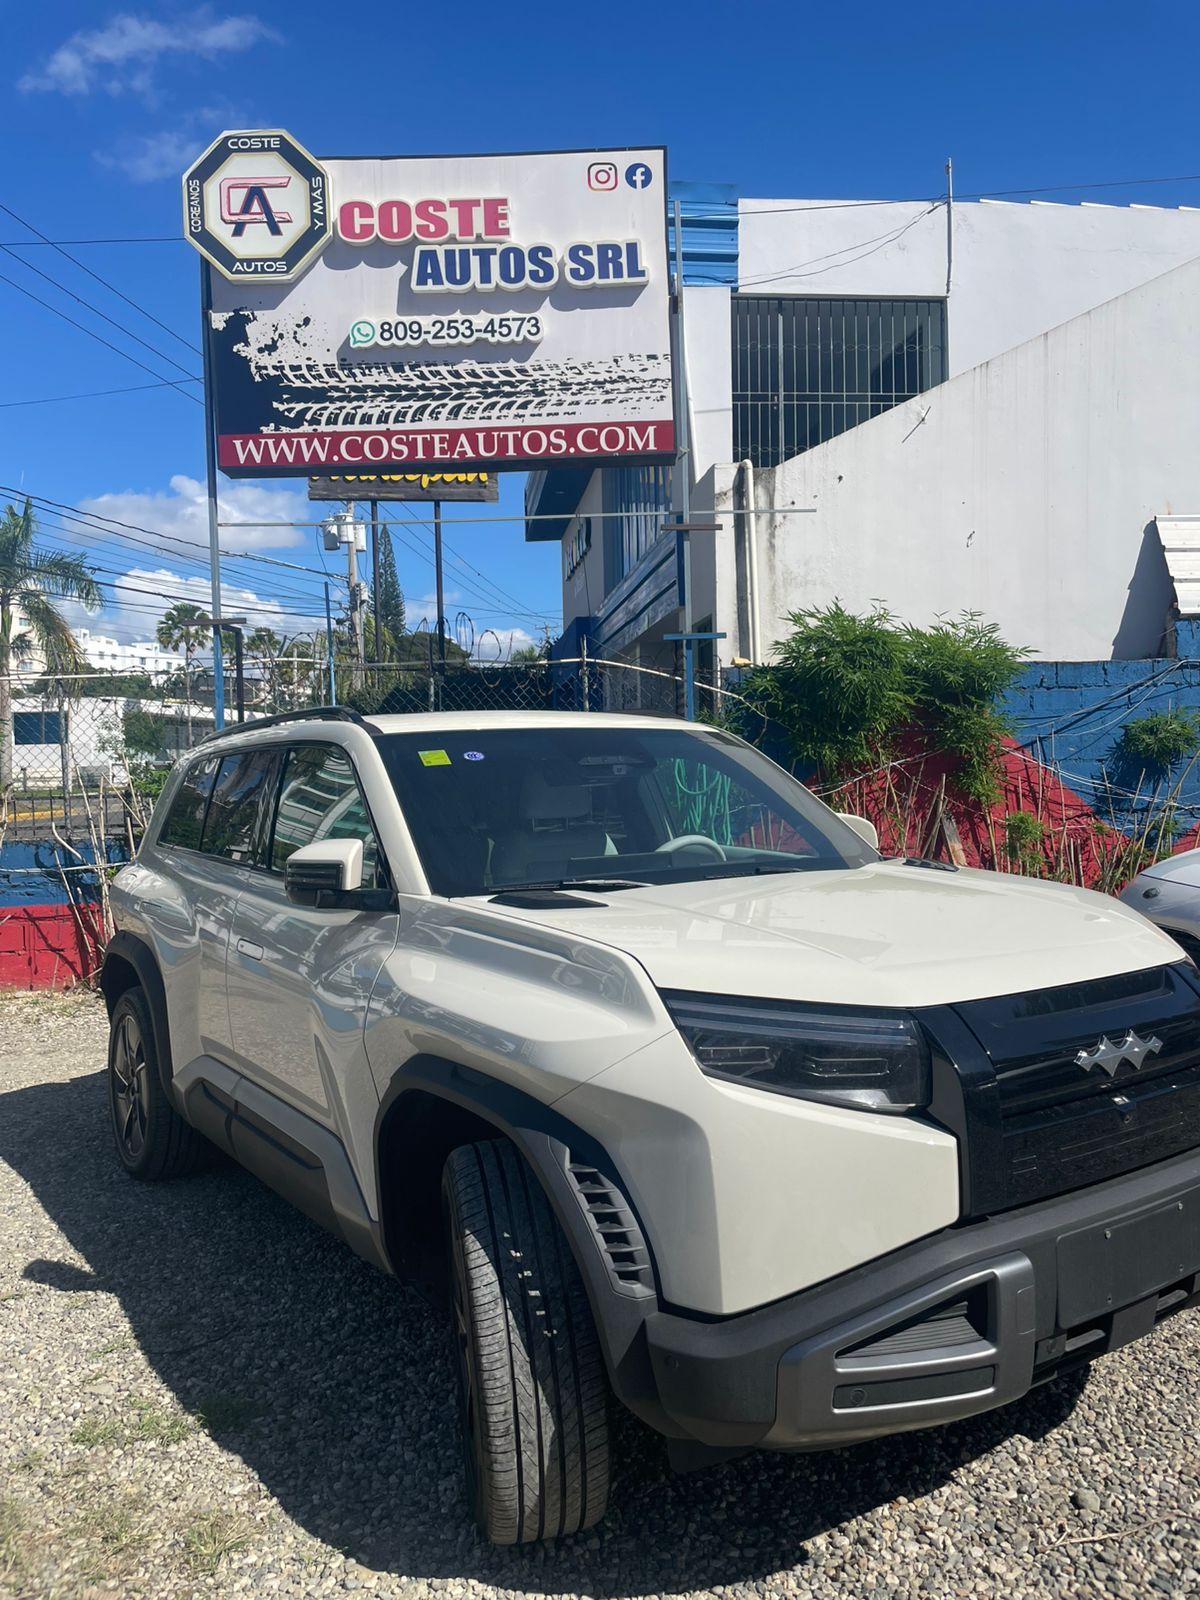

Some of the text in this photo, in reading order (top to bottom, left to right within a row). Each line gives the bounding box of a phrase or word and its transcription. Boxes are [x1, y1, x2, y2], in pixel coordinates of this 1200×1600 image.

[227, 138, 281, 149] COSTE
[190, 179, 201, 233] COREANOS
[339, 198, 510, 240] COSTE
[314, 220, 324, 230] Y
[232, 261, 287, 272] AUTOS
[415, 242, 646, 286] AUTOS SRL
[379, 316, 541, 342] 809-253-4573
[232, 425, 658, 464] WWW.COSTEAUTOS.COM
